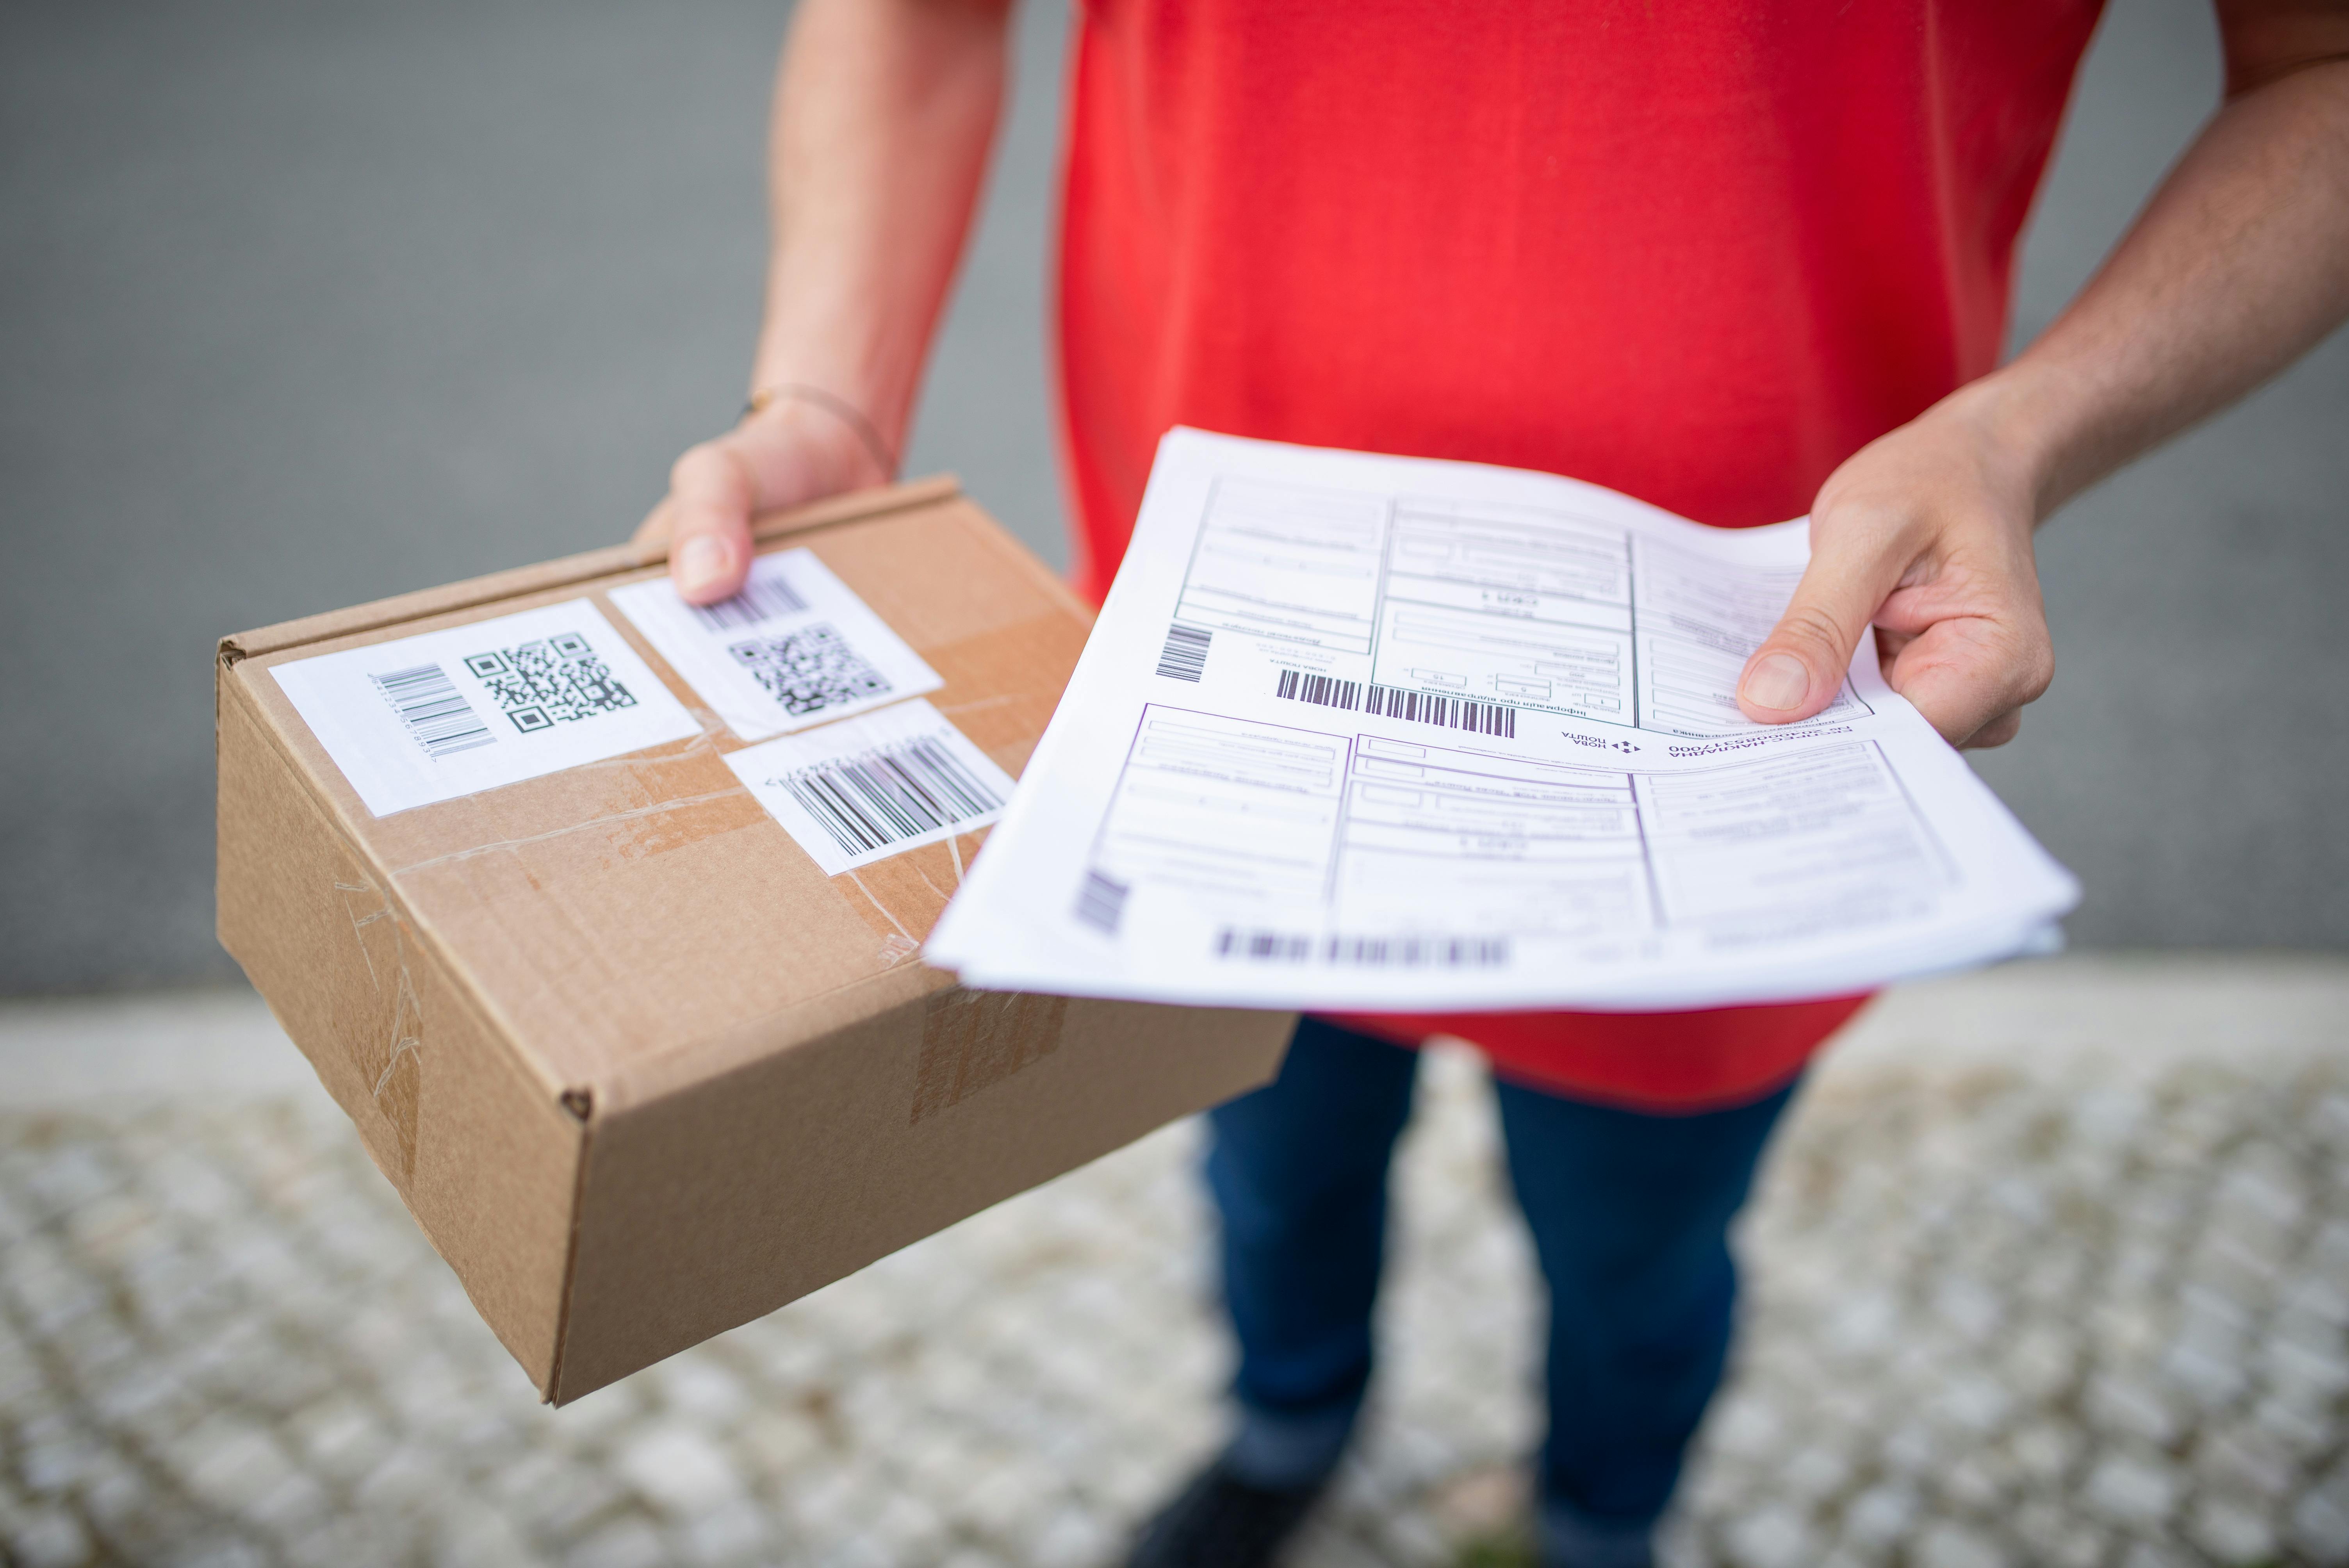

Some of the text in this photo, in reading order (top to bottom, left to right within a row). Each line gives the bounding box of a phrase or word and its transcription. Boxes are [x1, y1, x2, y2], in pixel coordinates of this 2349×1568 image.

[1269, 658, 1301, 668] ПОШТА
[1421, 686, 1496, 702] відправлення
[1523, 701, 1586, 716] Інформація
[1561, 732, 1606, 744] ПОШТА
[1572, 739, 1606, 749] НОВА
[1668, 730, 1822, 752] 20400085317000
[1668, 729, 1854, 757] ЕКСПРЕС-НАКЛАДНА
